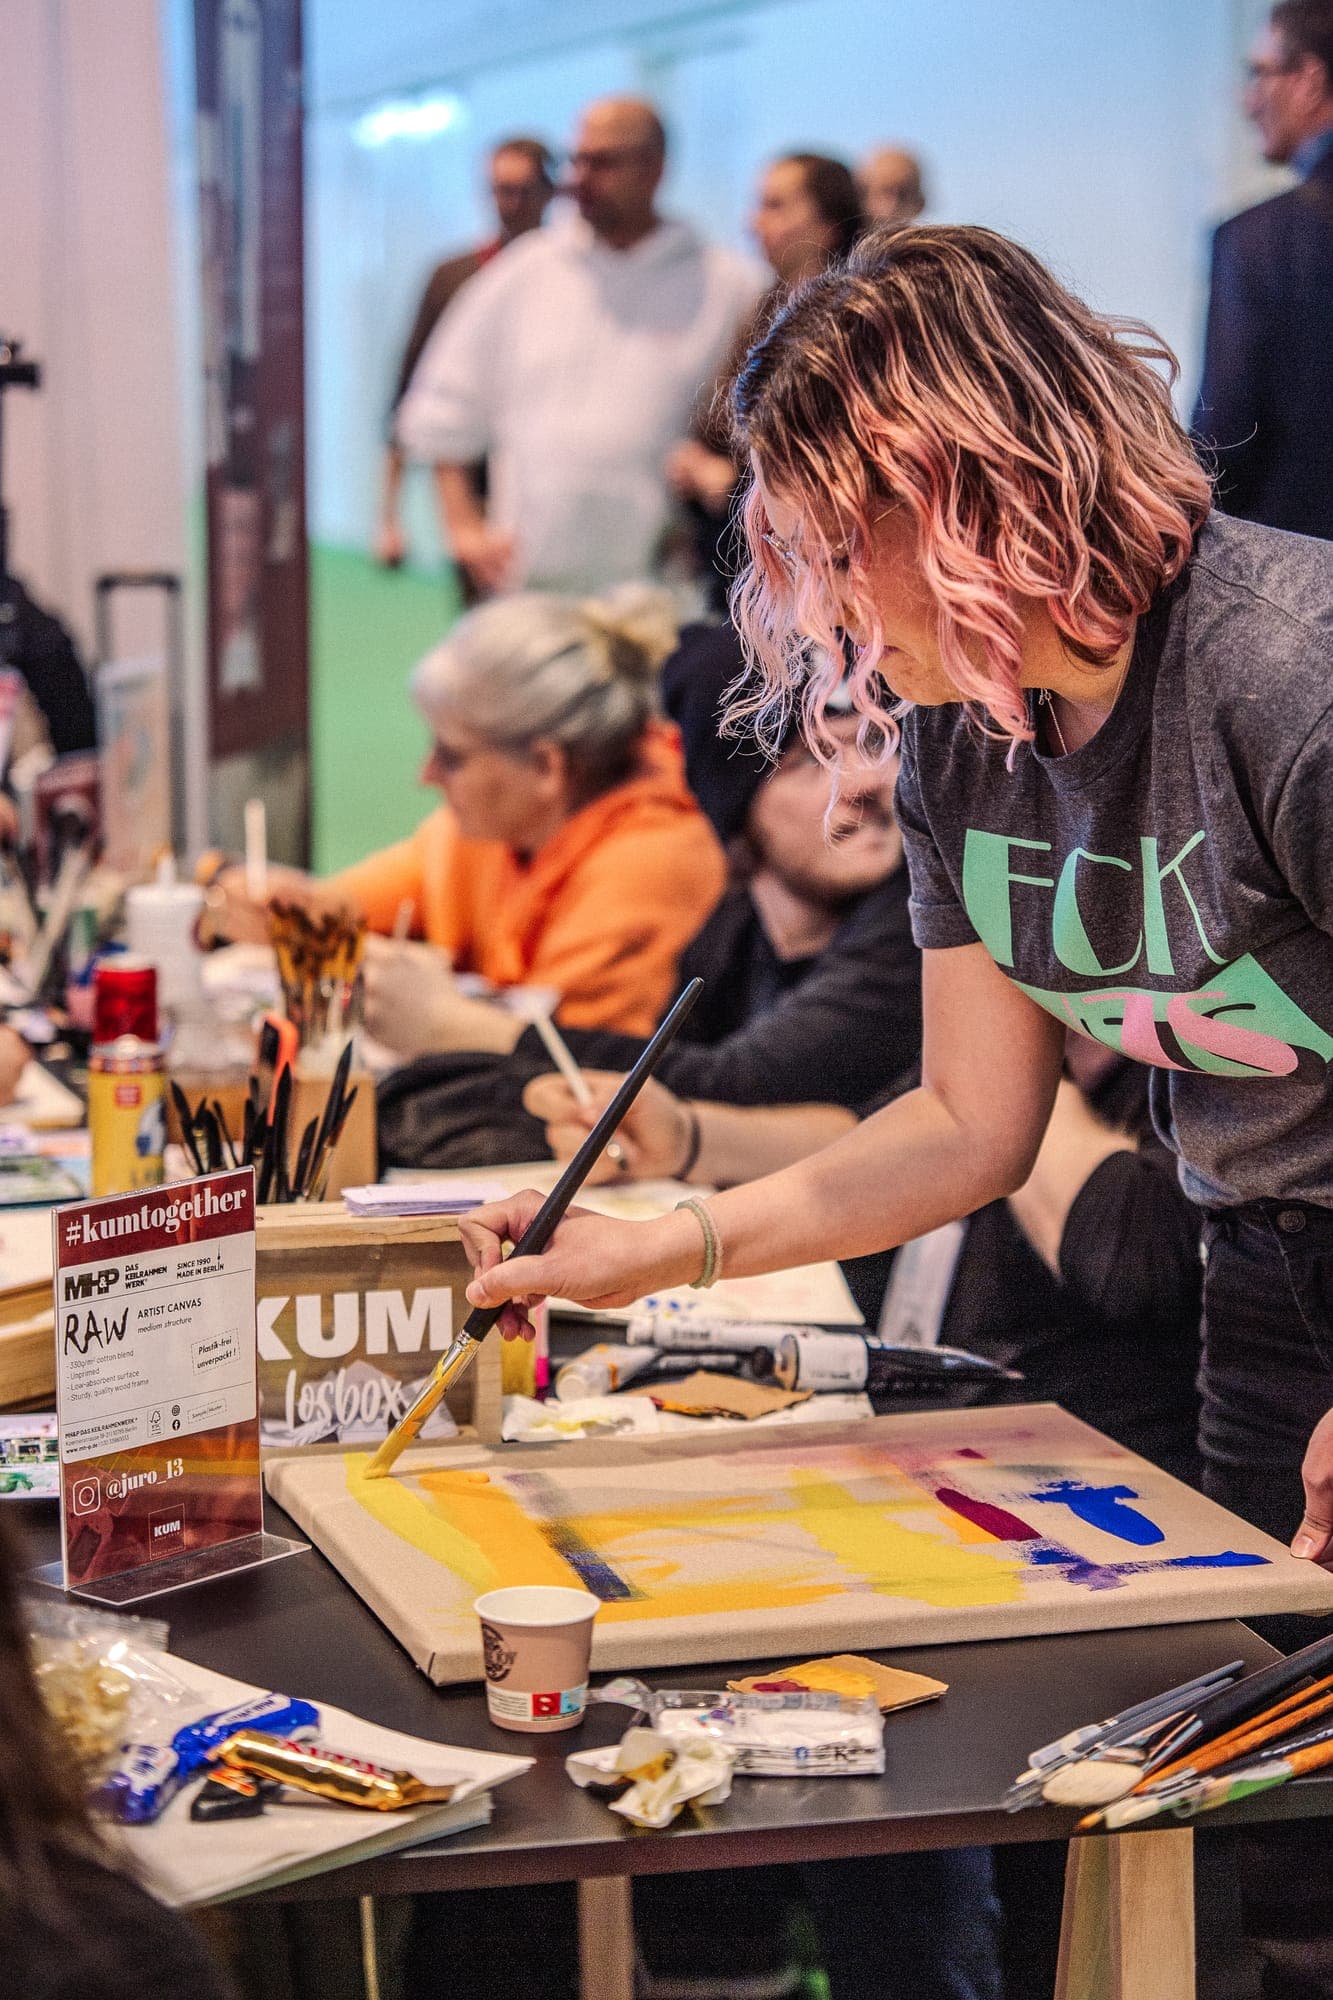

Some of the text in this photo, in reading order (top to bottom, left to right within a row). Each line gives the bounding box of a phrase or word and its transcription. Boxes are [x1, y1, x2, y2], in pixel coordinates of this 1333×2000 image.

[962, 828, 1229, 977] FCK
[65, 1187, 247, 1247] #kumtogether
[125, 1263, 140, 1273] DAS
[125, 1266, 168, 1281] KEILRAHMEN
[176, 1263, 225, 1279] MADE IN BERLIN
[177, 1257, 211, 1271] SINCE 1990
[137, 1297, 202, 1320] ARTIST CANVAS
[64, 1307, 129, 1356] RAW
[137, 1316, 192, 1334] medium structure
[256, 1286, 454, 1362] KUM
[114, 1382, 131, 1392] wood
[106, 1457, 184, 1499] @juro_13
[154, 1519, 181, 1538] KUM
